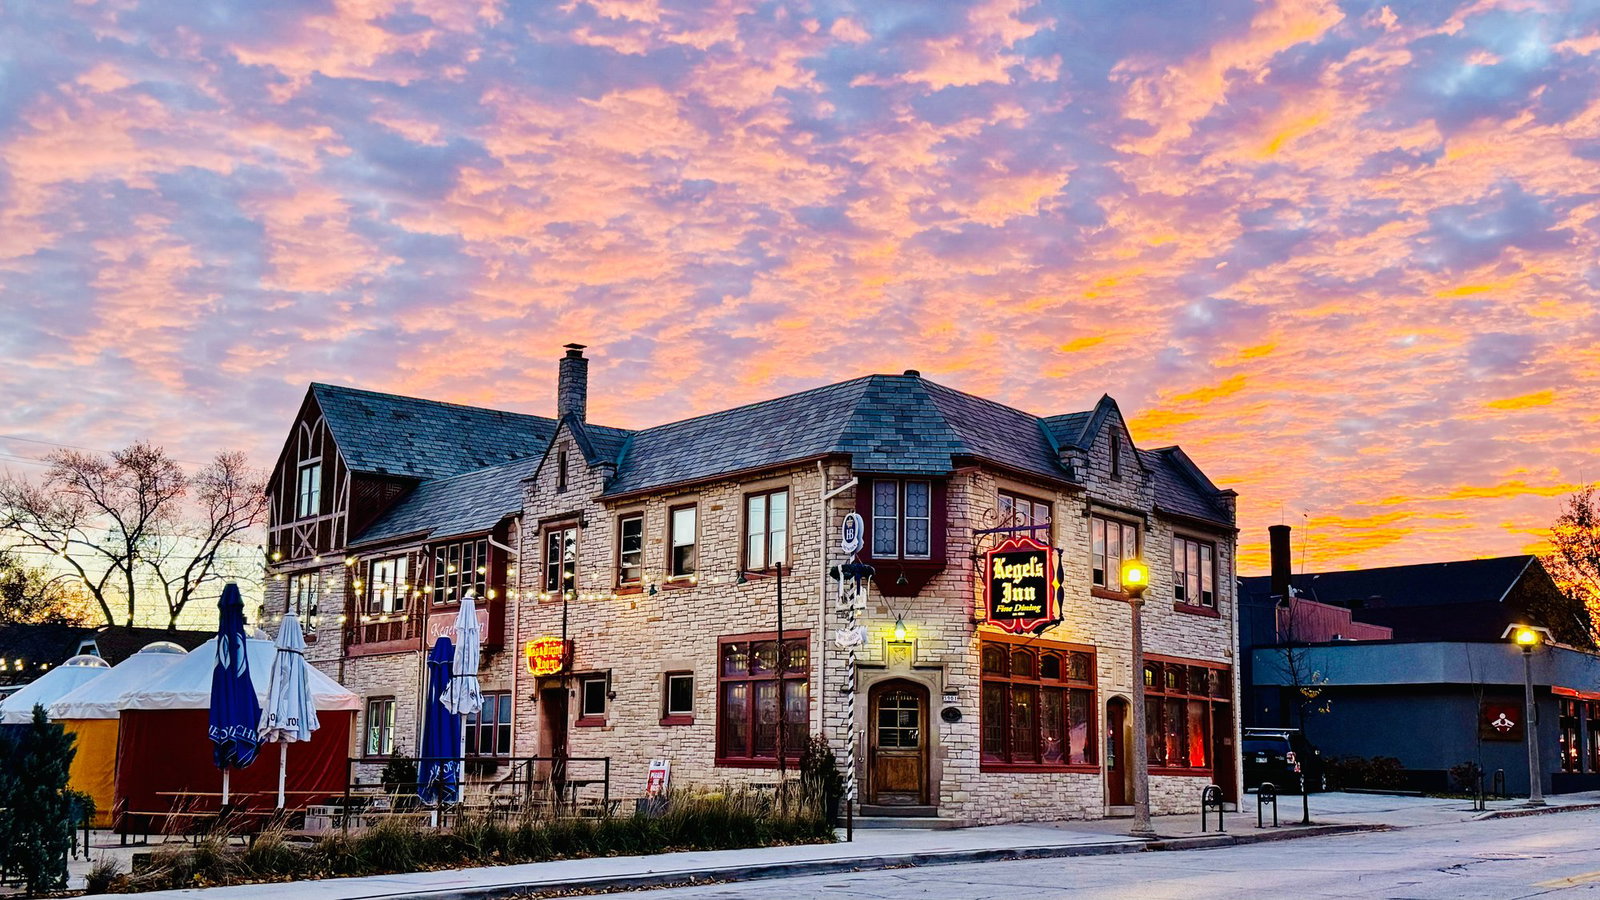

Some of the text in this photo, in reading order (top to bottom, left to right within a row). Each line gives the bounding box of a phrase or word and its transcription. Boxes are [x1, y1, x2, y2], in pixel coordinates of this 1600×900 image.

[846, 528, 854, 540] HB
[993, 556, 1044, 584] Kegel's
[1001, 582, 1036, 603] Inn
[996, 603, 1042, 613] Fine Dining
